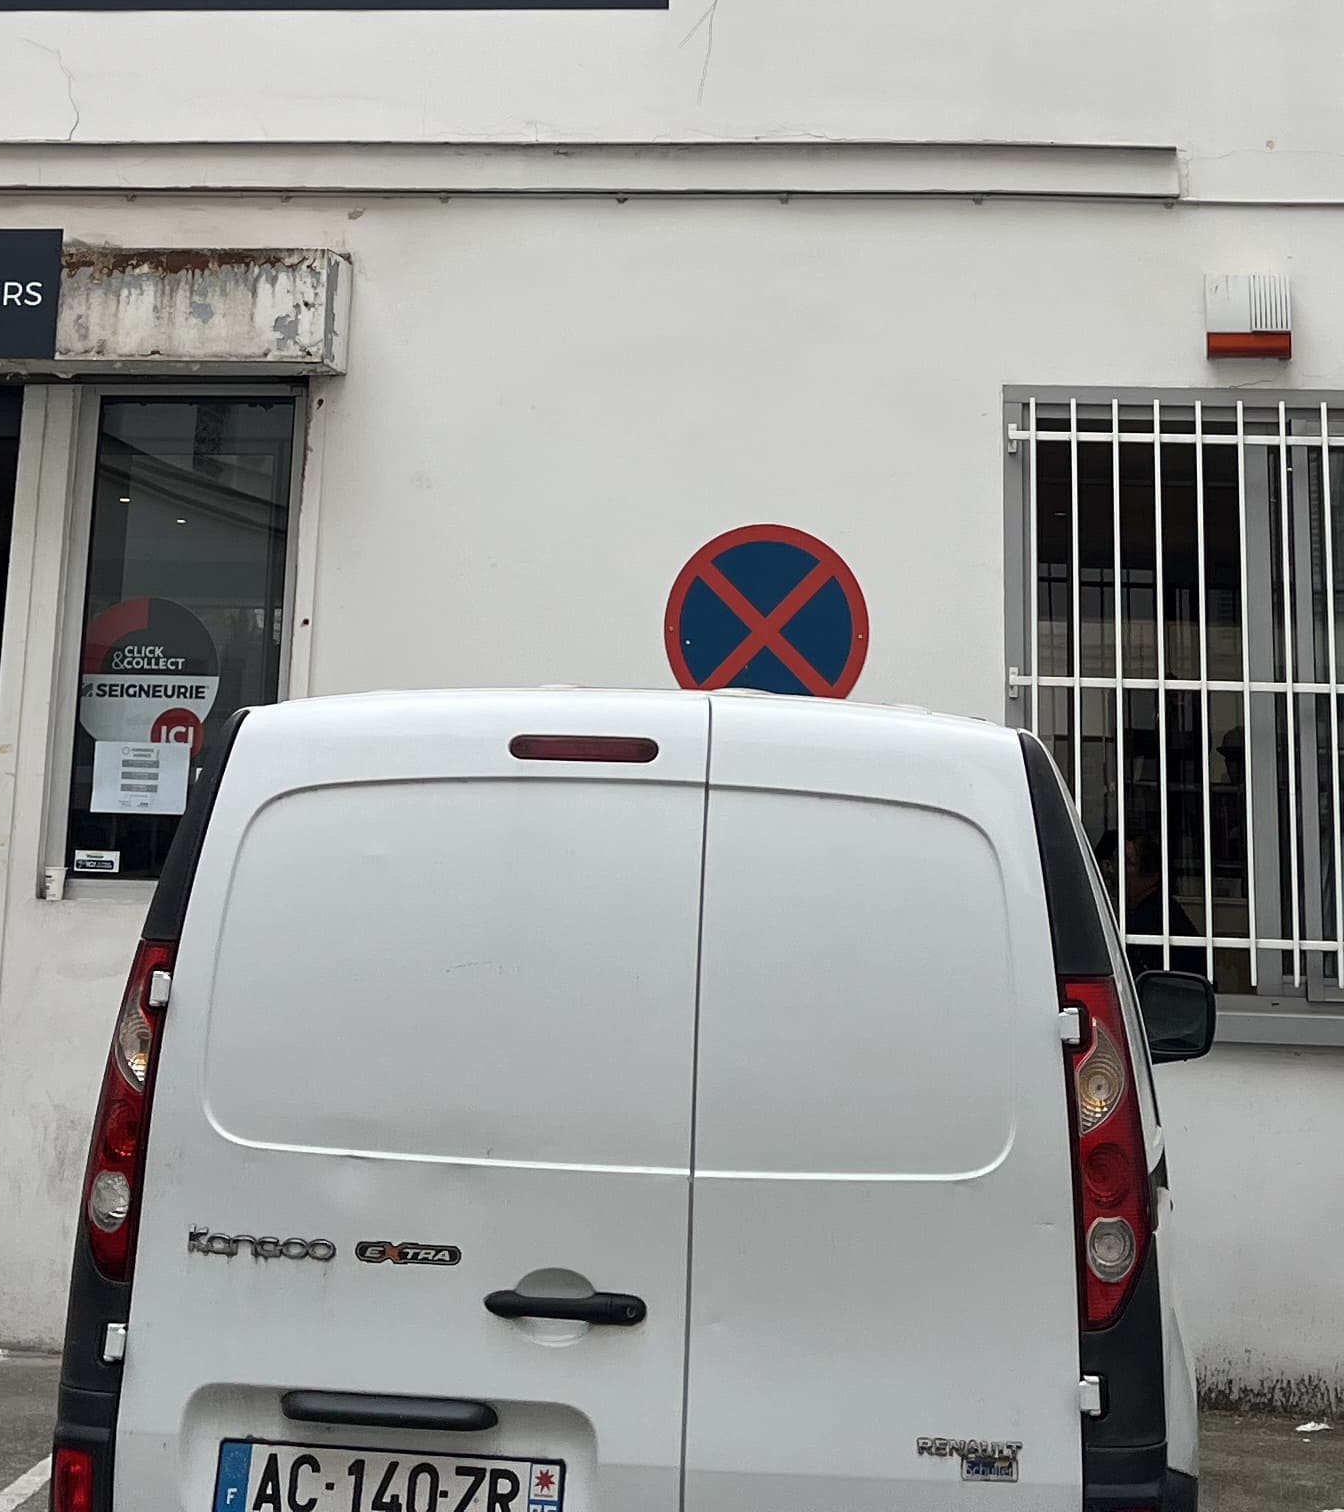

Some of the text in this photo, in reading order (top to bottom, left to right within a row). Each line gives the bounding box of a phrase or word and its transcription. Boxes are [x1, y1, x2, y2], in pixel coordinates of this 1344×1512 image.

[124, 645, 165, 658] CLICK
[95, 683, 207, 700] SEIGNEURIE
[364, 1243, 452, 1262] EXTRA
[916, 1437, 1023, 1461] RENAULT
[252, 1452, 522, 1512] AC-140-ZR
[226, 1487, 238, 1505] F
